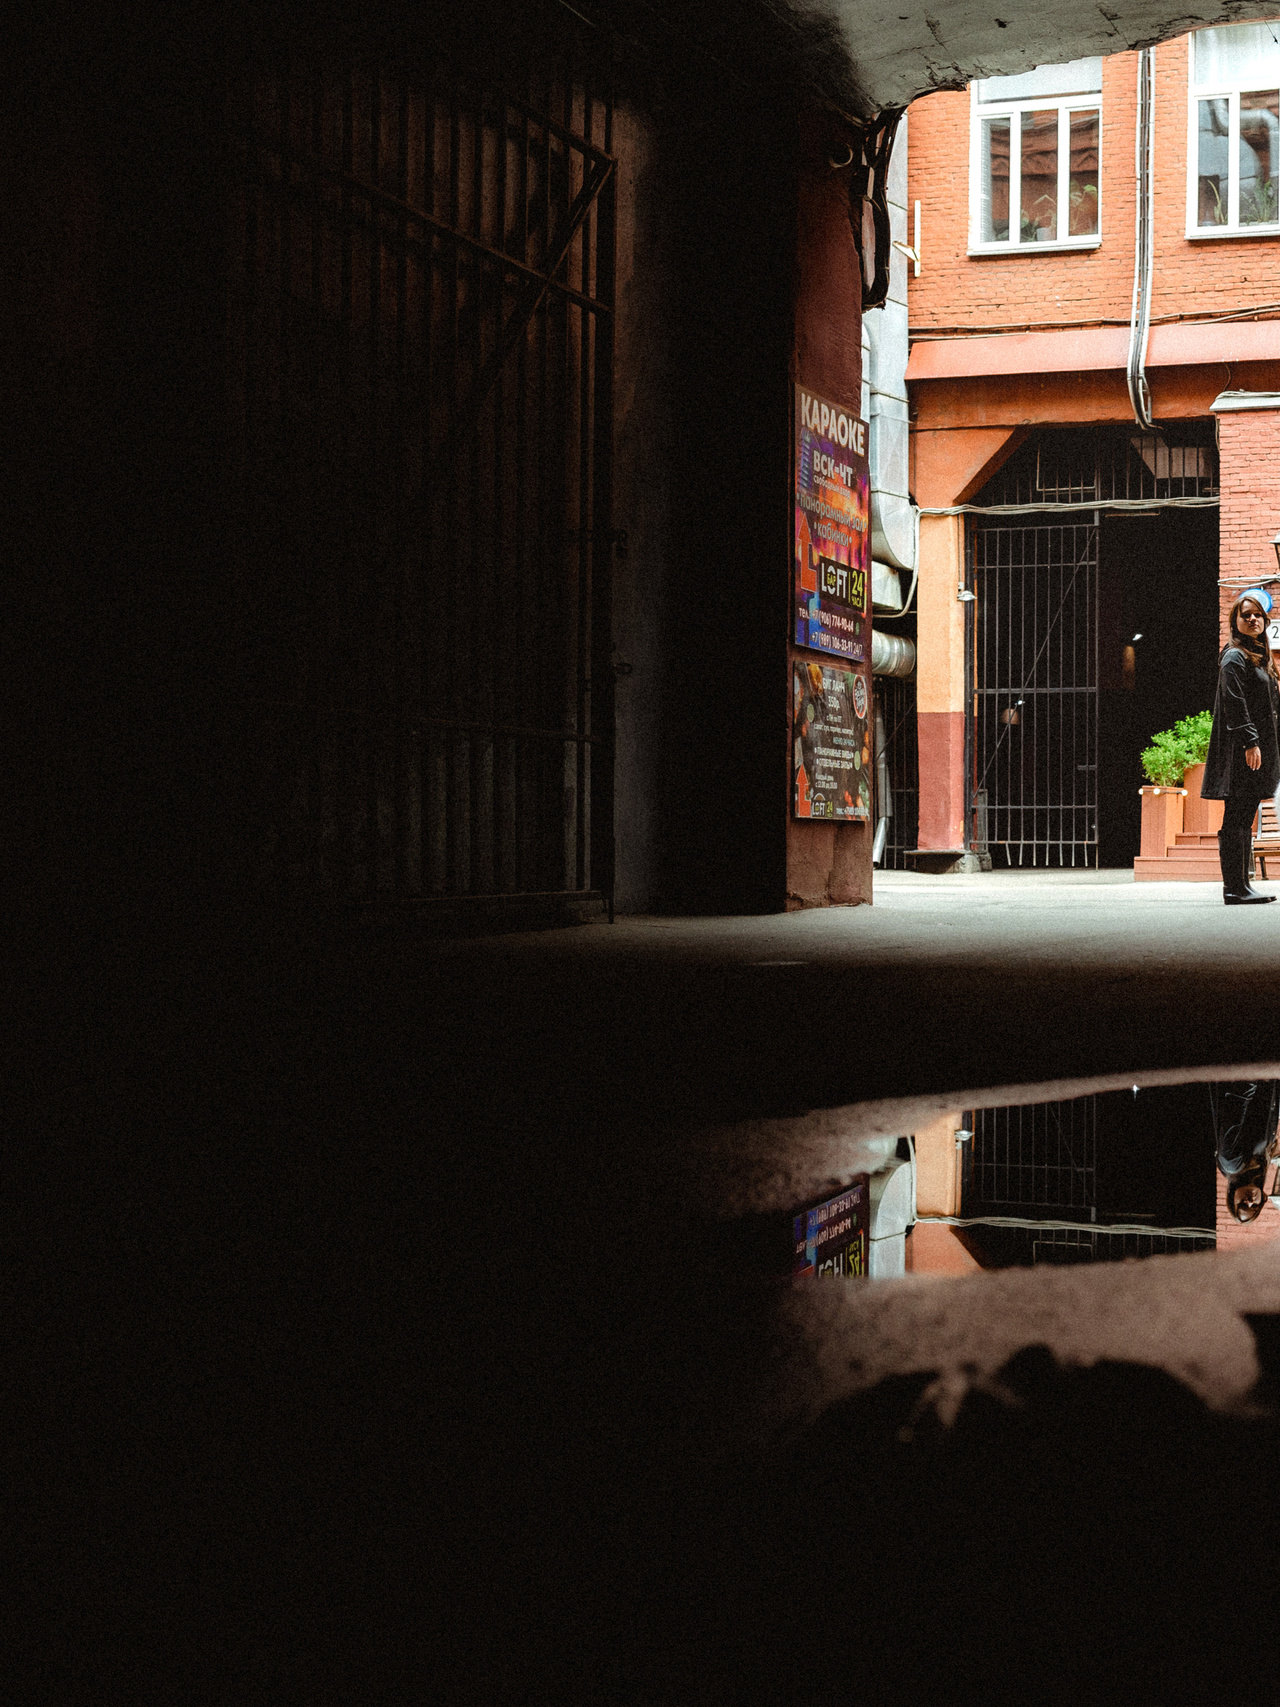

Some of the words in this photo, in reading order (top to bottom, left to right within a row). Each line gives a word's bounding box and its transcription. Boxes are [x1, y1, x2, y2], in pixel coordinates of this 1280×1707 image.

[801, 393, 865, 458] КАРАОКЕ
[821, 562, 848, 599] LOFT
[851, 570, 863, 597] 24
